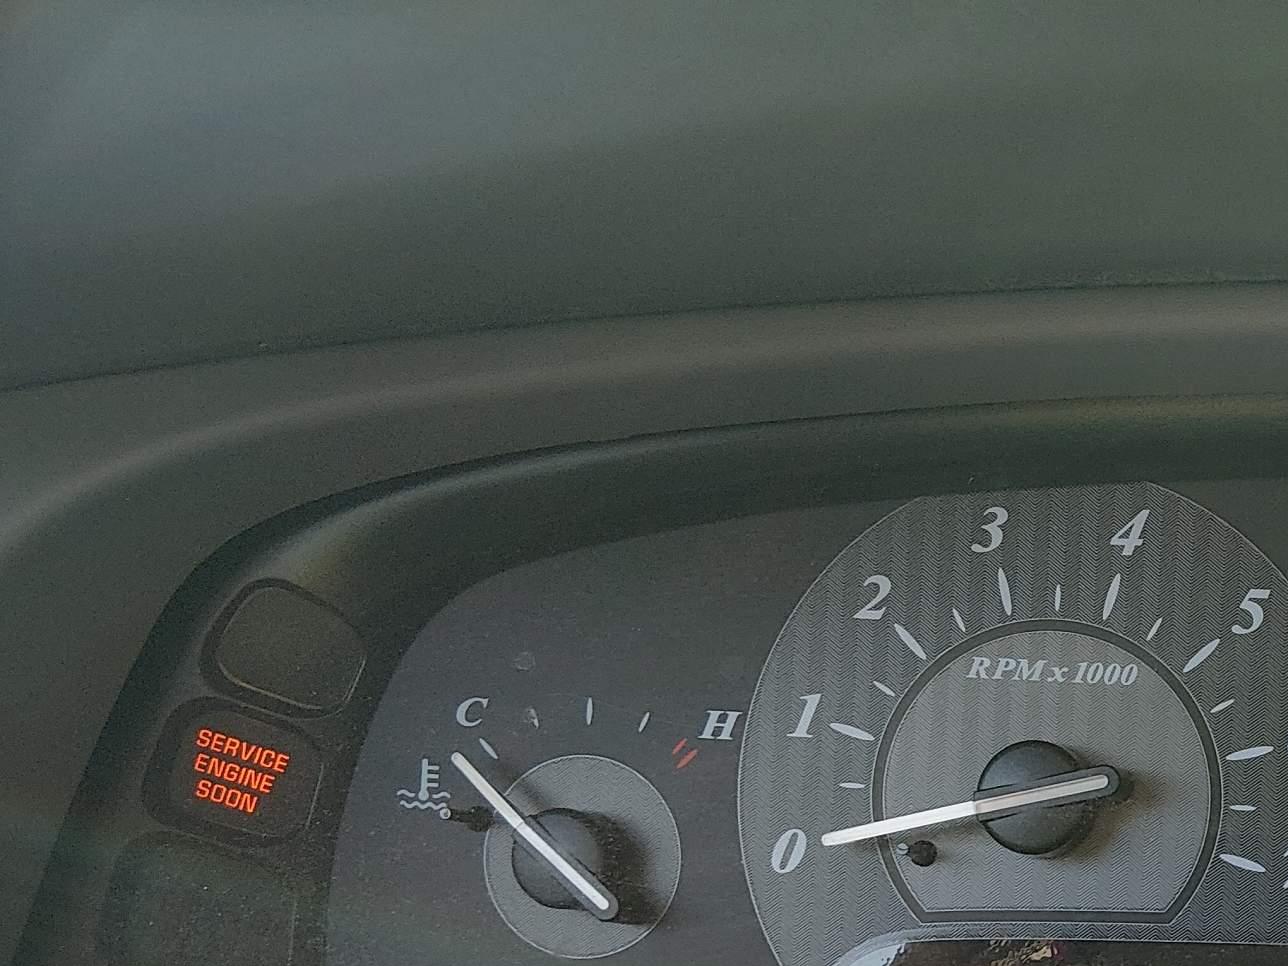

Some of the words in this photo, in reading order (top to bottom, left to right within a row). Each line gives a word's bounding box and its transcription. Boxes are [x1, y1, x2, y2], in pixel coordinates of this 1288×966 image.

[971, 507, 1008, 553] 3
[1110, 509, 1150, 556] 4
[854, 574, 891, 620] 2
[1231, 589, 1271, 635] 5
[966, 656, 1047, 683] RPM
[1048, 665, 1068, 683] x
[1071, 661, 1138, 686] 1000
[455, 697, 488, 727] C
[698, 709, 742, 740] H
[786, 694, 822, 740] 1
[194, 753, 276, 793] ENGINE
[196, 729, 290, 773] SERVICE
[195, 779, 258, 813] SOON
[771, 829, 806, 873] 0
